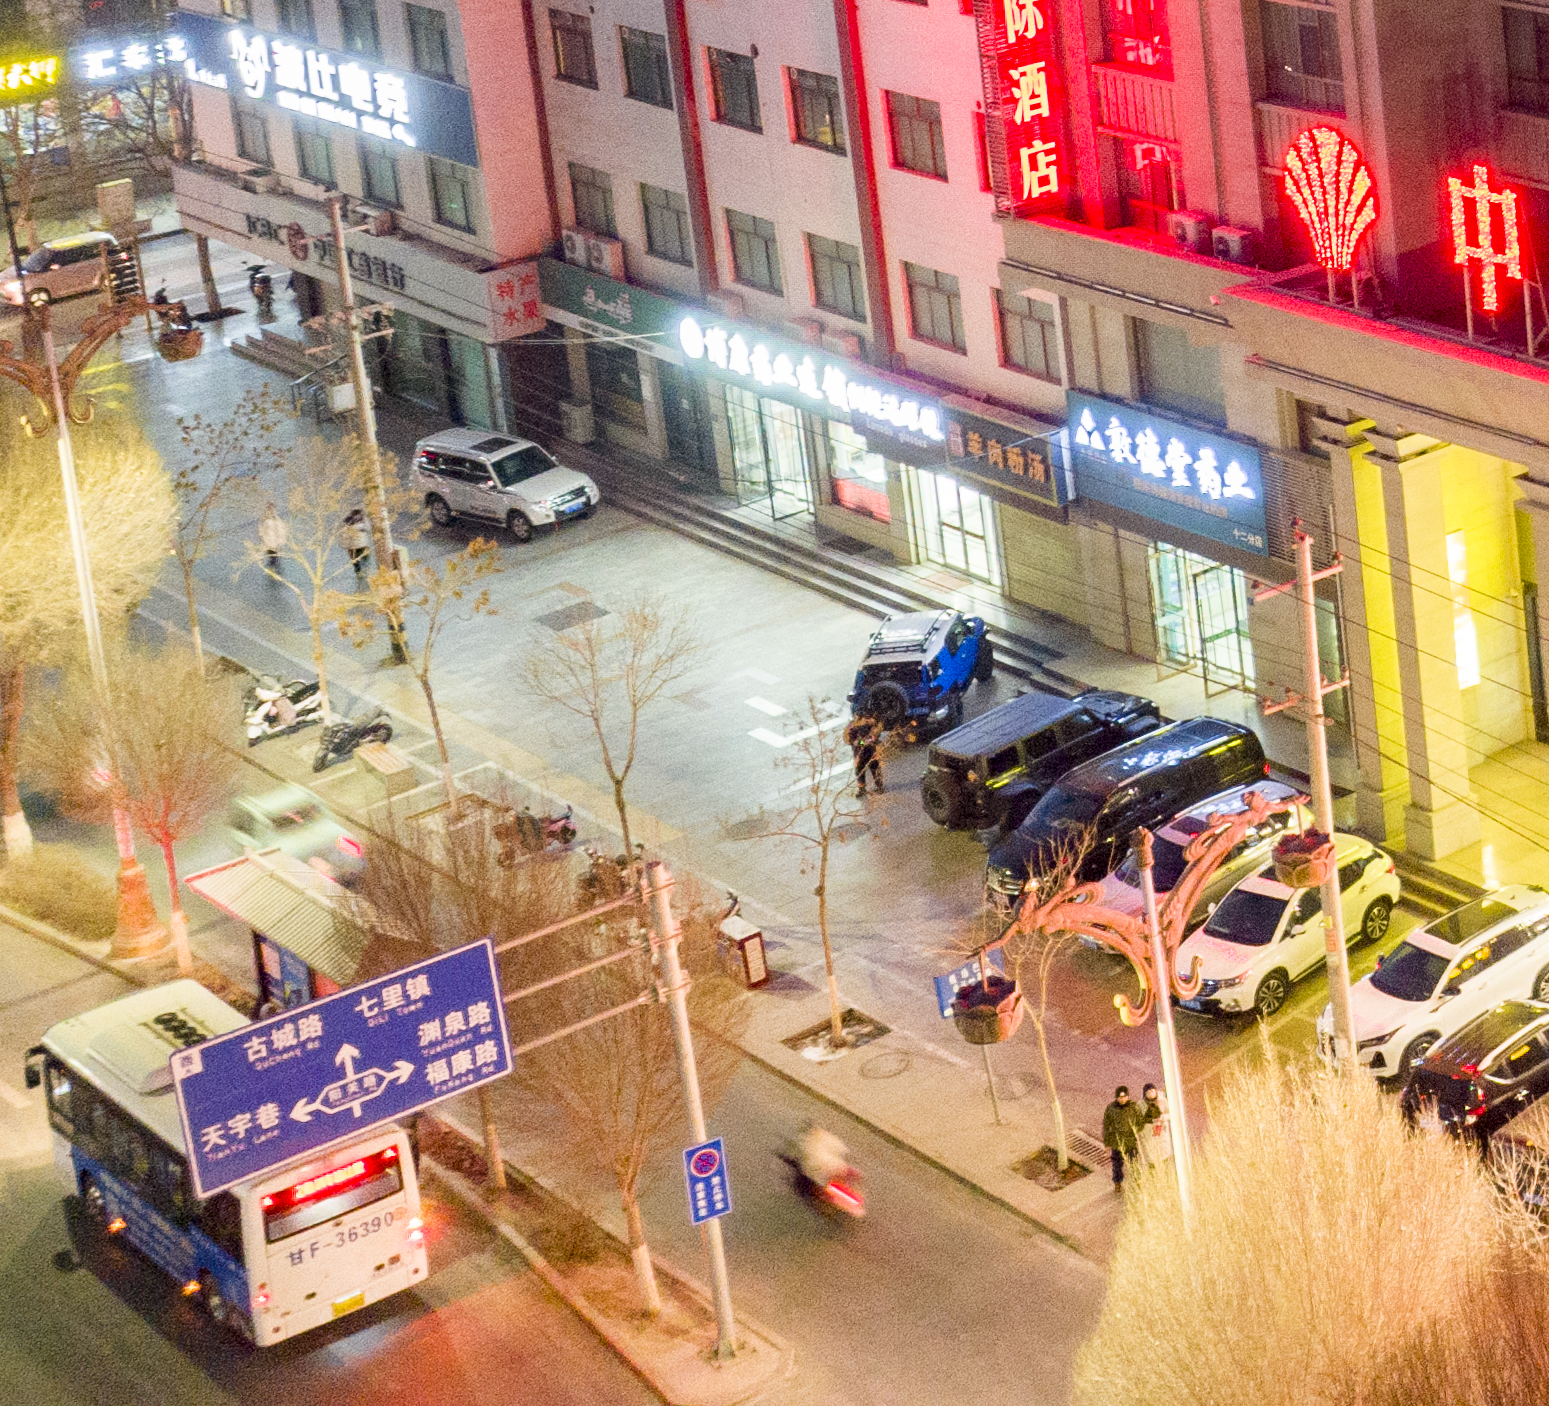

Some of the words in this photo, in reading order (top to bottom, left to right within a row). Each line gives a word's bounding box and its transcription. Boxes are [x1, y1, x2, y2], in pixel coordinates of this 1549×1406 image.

[355, 974, 431, 1018] 七里镇
[243, 1014, 323, 1061] 古城路
[418, 1001, 492, 1045] 渊泉路
[425, 1040, 498, 1085] 福康路
[201, 1102, 280, 1152] 天宇巷
[289, 1212, 394, 1266] 甘F-36390
